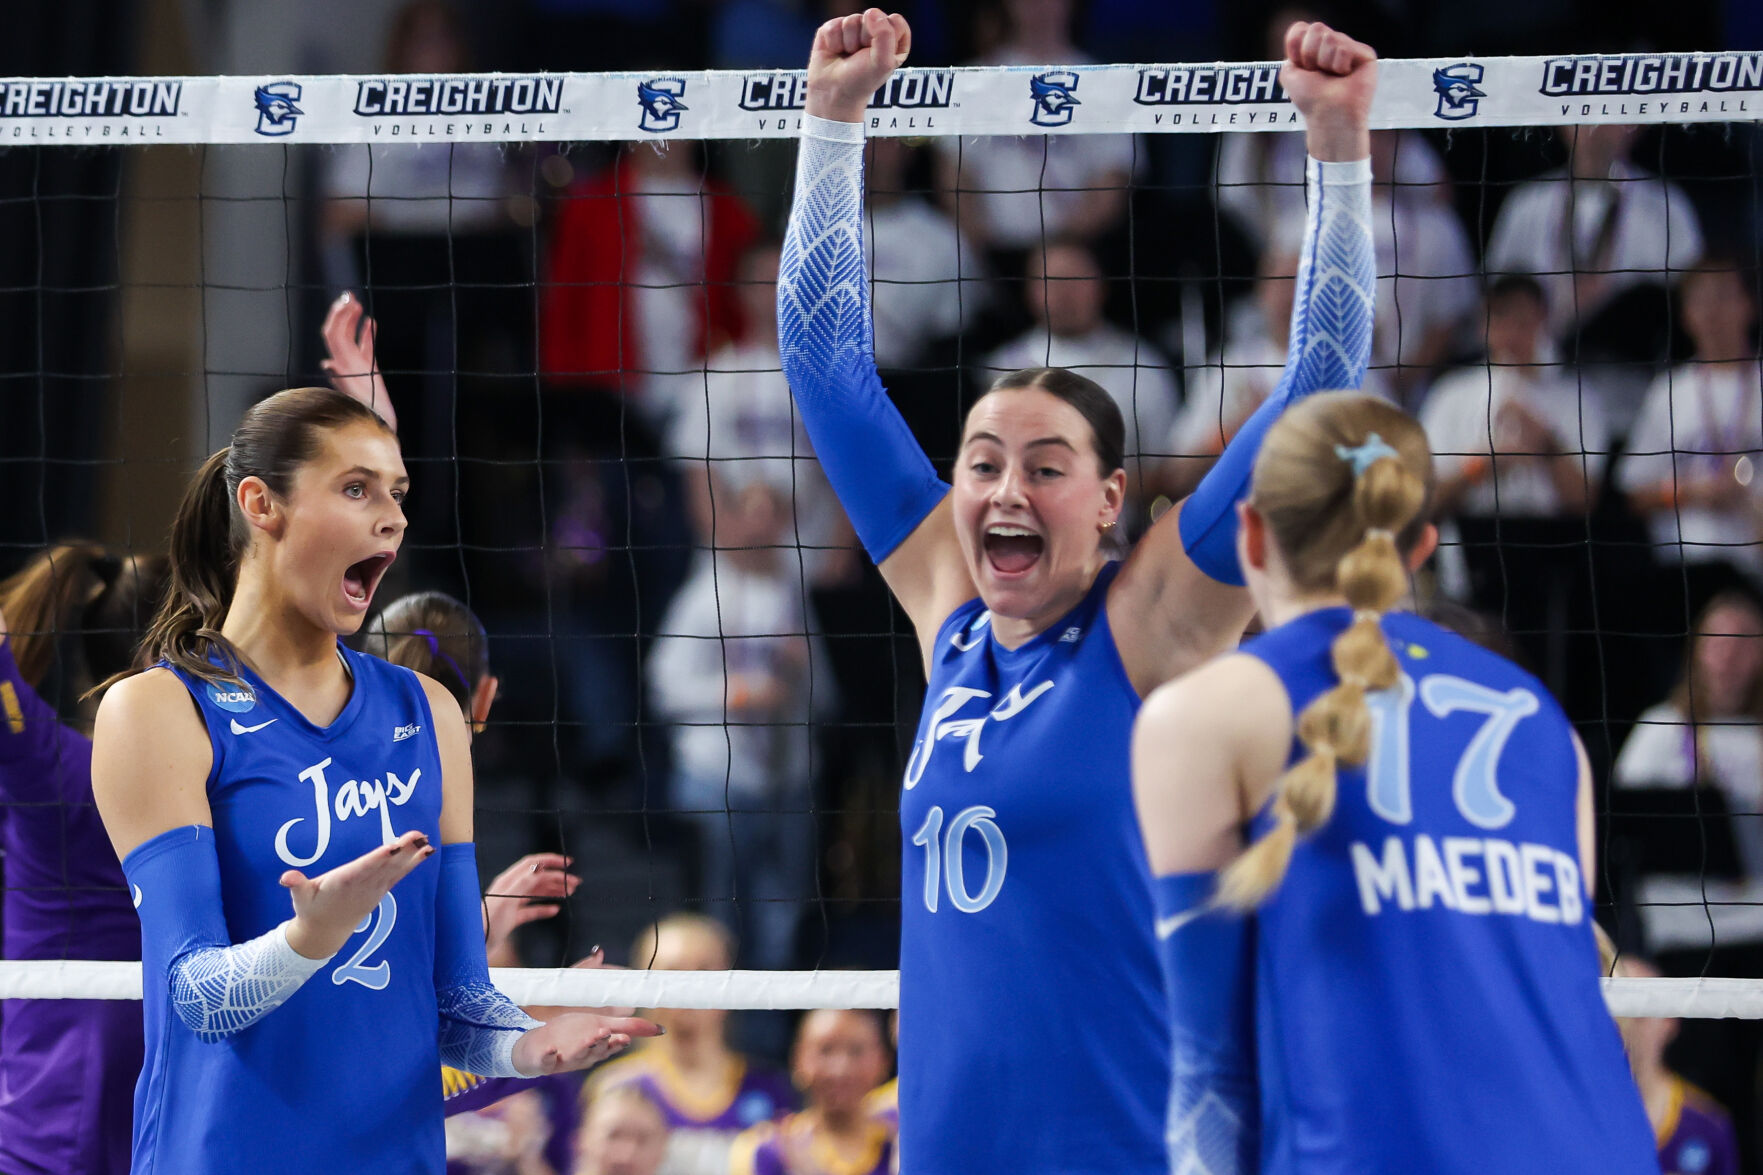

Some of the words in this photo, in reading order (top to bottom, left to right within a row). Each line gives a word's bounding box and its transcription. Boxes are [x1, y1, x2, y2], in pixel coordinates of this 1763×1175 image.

[738, 72, 955, 111] CRETON
[1133, 68, 1292, 105] CREIGH
[1538, 55, 1763, 96] CREIGHTON
[0, 80, 183, 117] REIGHTON
[353, 78, 565, 116] CREIGHTON
[1561, 101, 1748, 116] VOLLEYBALL
[0, 125, 163, 137] OLLEYBALL
[374, 123, 545, 136] VOLLEYBALL
[759, 117, 935, 130] VOLBALL
[1155, 112, 1297, 124] VOLLEYBA
[1365, 671, 1540, 830] 17
[274, 757, 421, 867] Jays
[913, 805, 1008, 913] 10
[332, 891, 397, 990] 2
